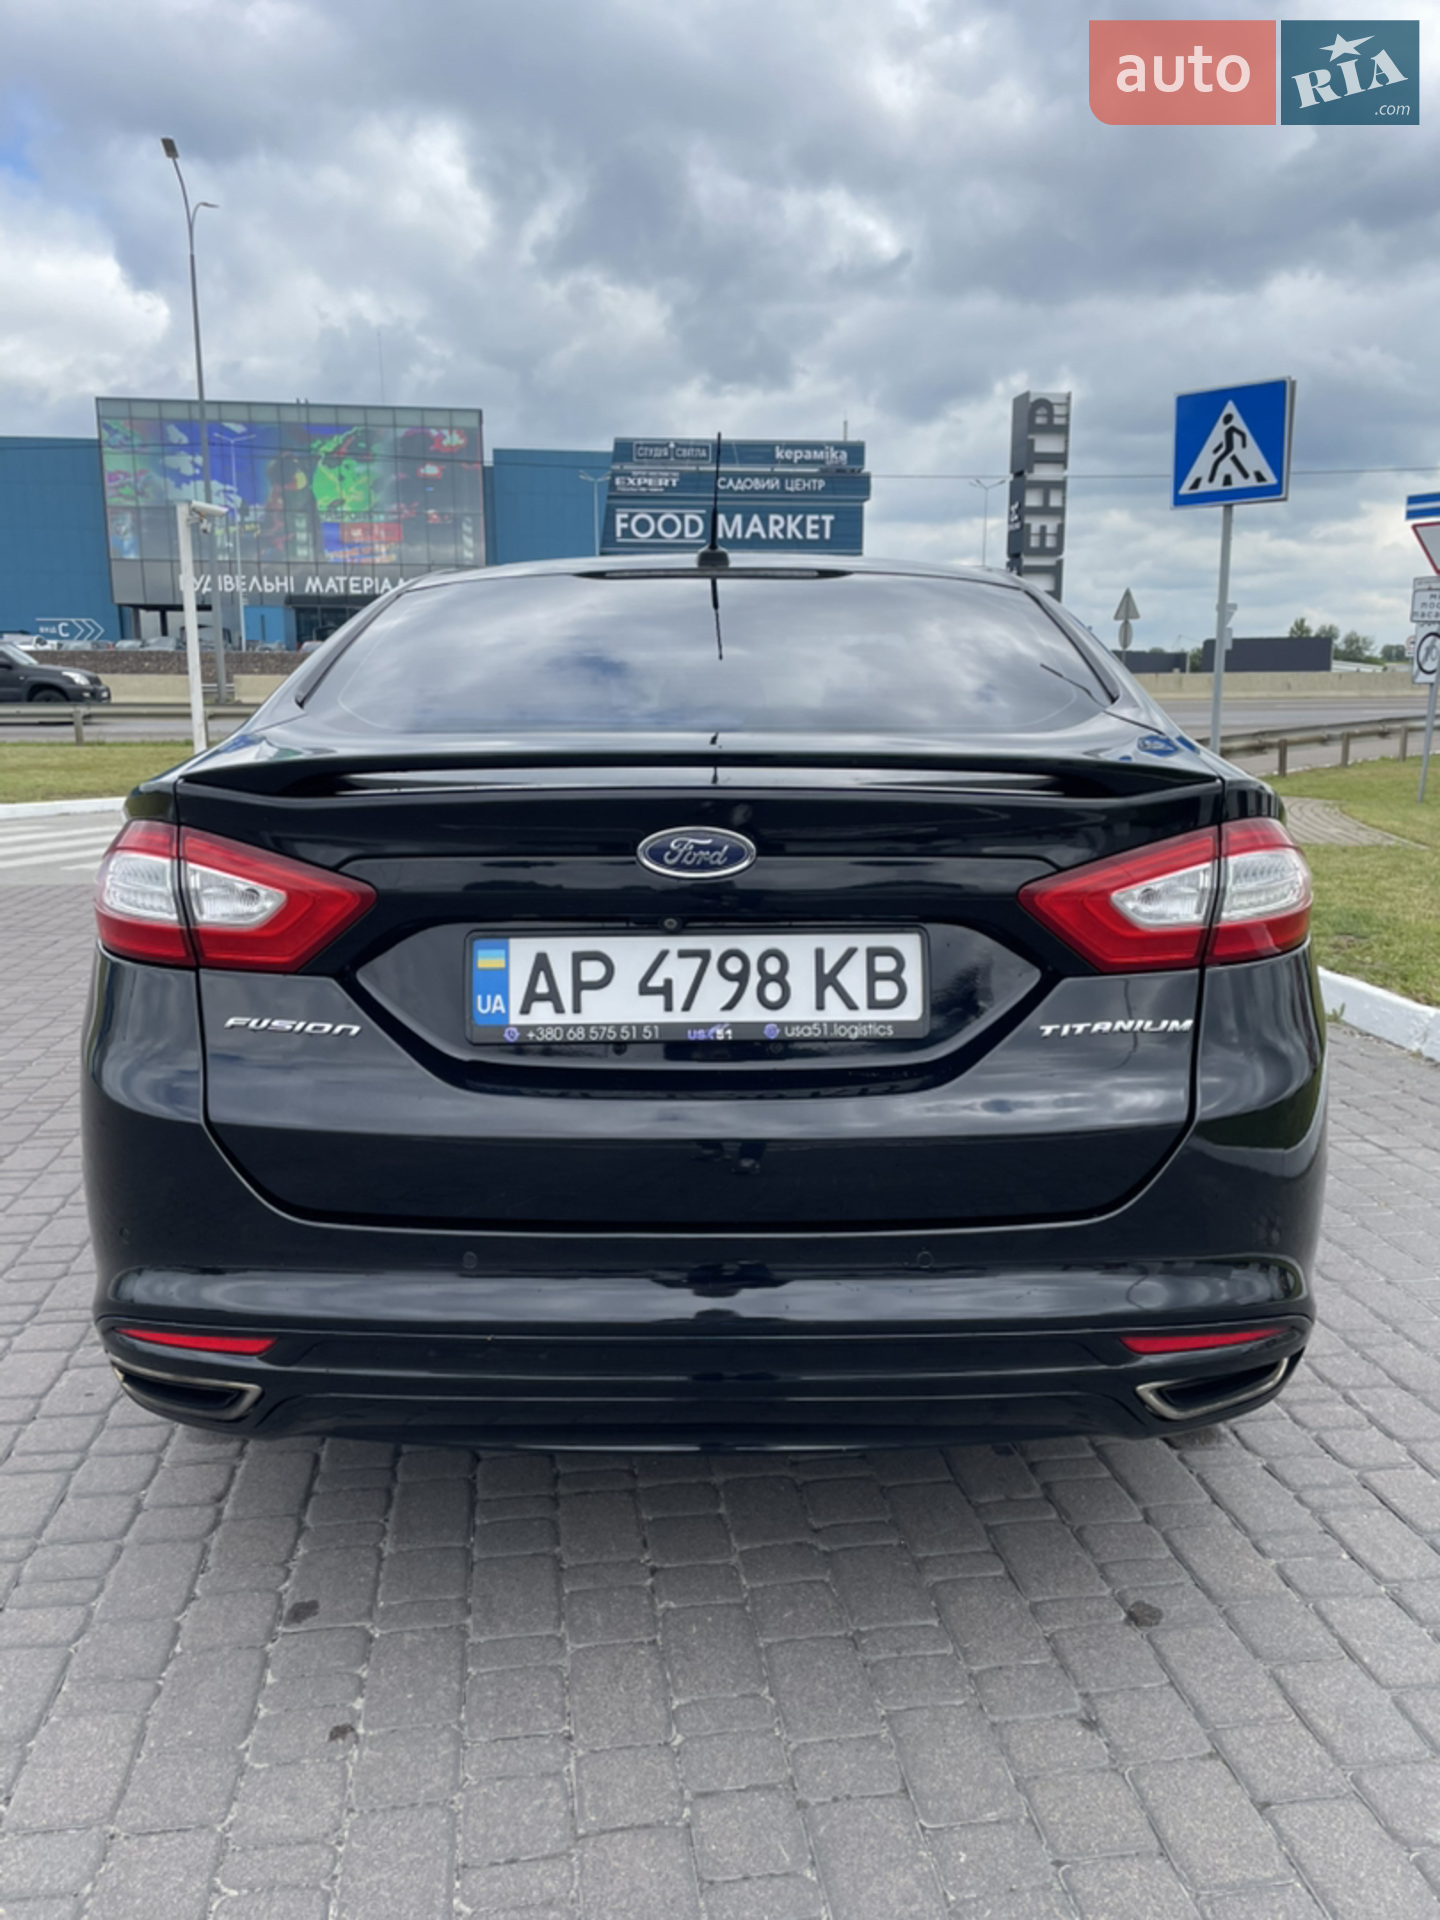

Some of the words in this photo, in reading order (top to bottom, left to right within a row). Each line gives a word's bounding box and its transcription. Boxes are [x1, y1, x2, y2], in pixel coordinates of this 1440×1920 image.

[615, 476, 679, 487] EXPERT
[717, 475, 780, 490] САДОВИЙ
[785, 480, 825, 492] ЦЕНТР
[615, 512, 705, 539] FOOD
[717, 513, 835, 540] MARKET
[664, 837, 729, 865] Ford
[519, 951, 615, 1014] AP
[638, 948, 791, 1012] 4798
[815, 947, 908, 1011] KB
[476, 994, 506, 1014] UA
[224, 1016, 361, 1037] FUSION
[527, 1027, 563, 1041] +380
[567, 1027, 585, 1041] 68
[590, 1026, 617, 1040] 575
[620, 1026, 637, 1040] 51
[642, 1025, 659, 1039] 51
[785, 1023, 893, 1040] usa51.logistics
[1039, 1019, 1194, 1038] TITANIUM
